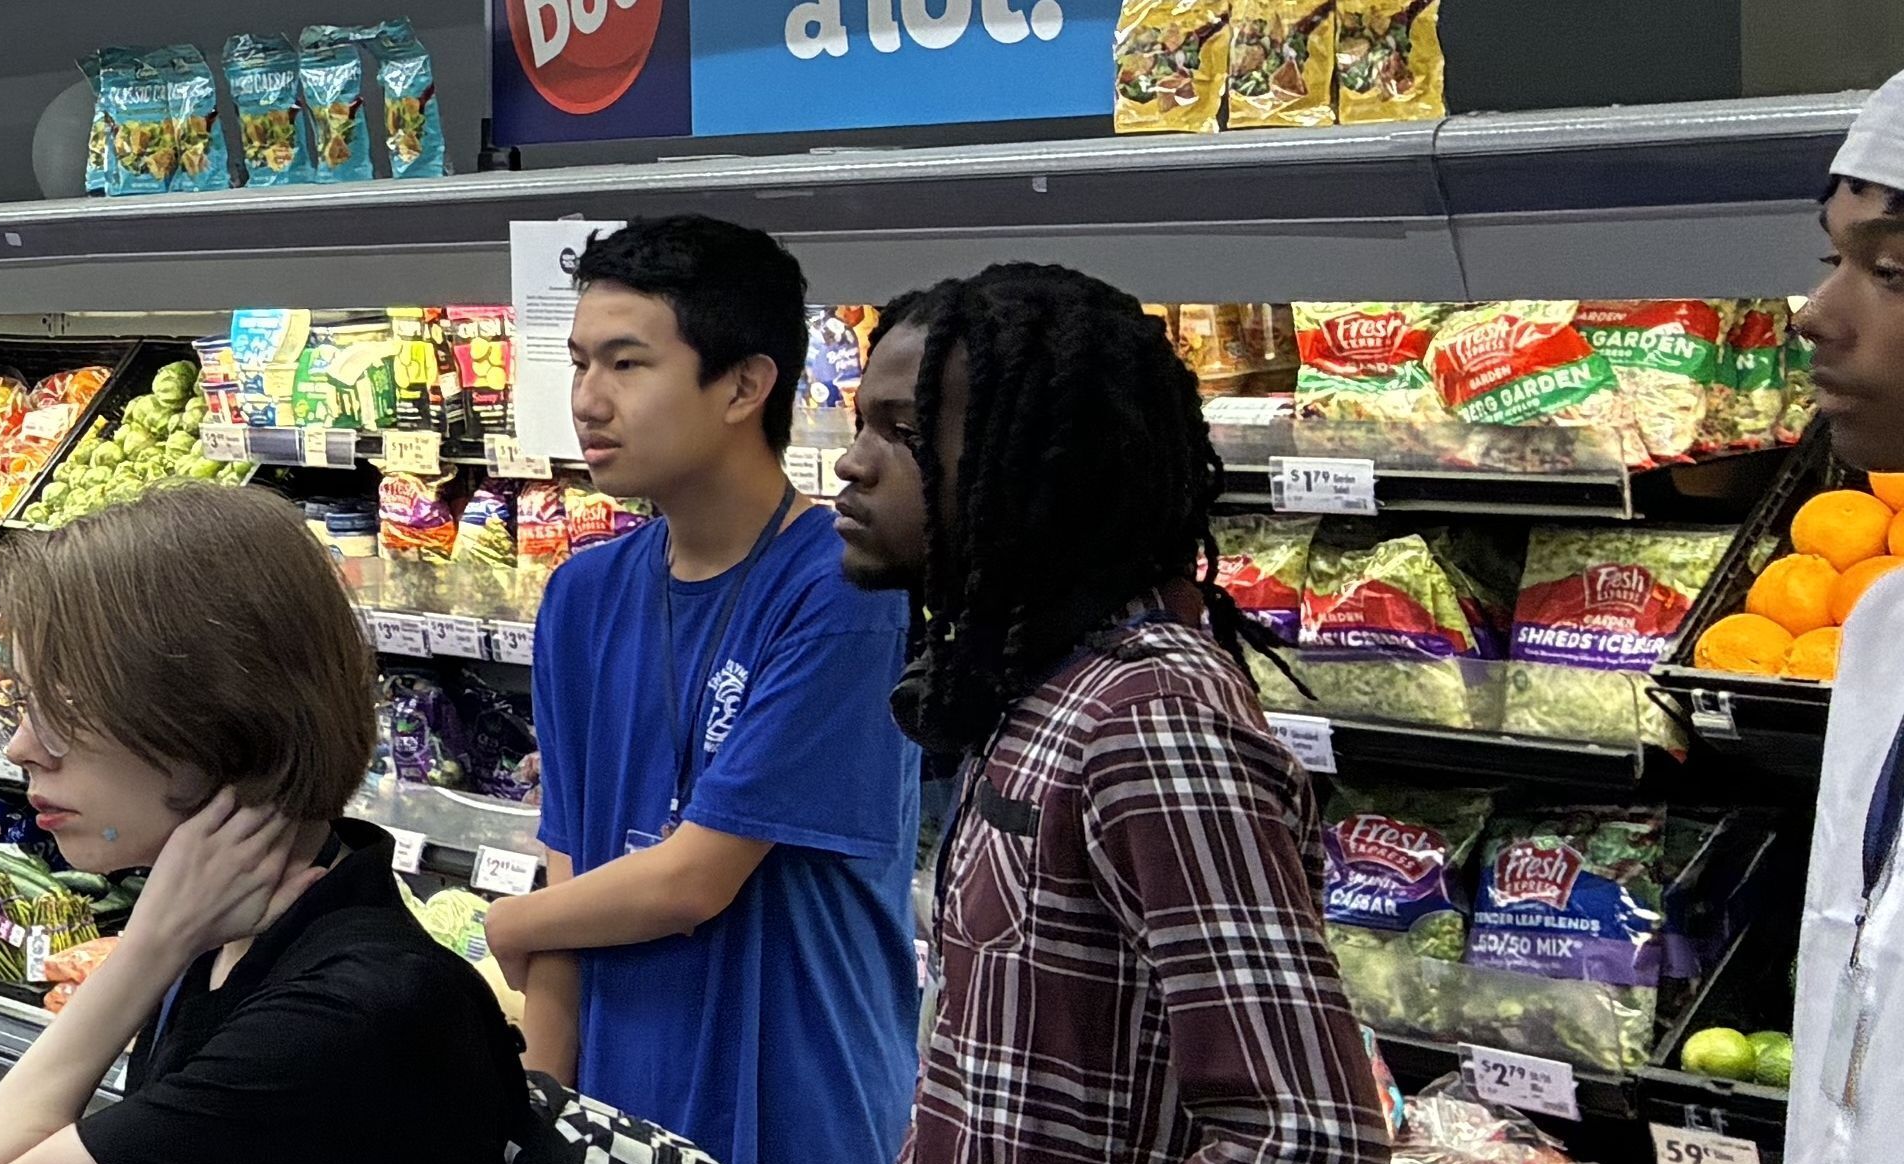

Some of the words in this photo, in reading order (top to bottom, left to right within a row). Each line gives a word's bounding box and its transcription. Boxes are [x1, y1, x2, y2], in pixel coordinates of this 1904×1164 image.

[525, 0, 634, 68] Do
[1577, 311, 1628, 322] ARDEN
[1457, 315, 1511, 356] Fresh
[1592, 330, 1696, 359] GARDEN
[1500, 363, 1592, 403] GARDEN
[1291, 469, 1331, 493] $179
[1350, 817, 1432, 852] Fresh
[1505, 848, 1569, 884] Fresh
[1329, 891, 1399, 916] CAESAR
[1543, 915, 1602, 932] BLENDS
[1481, 1060, 1526, 1087] $279
